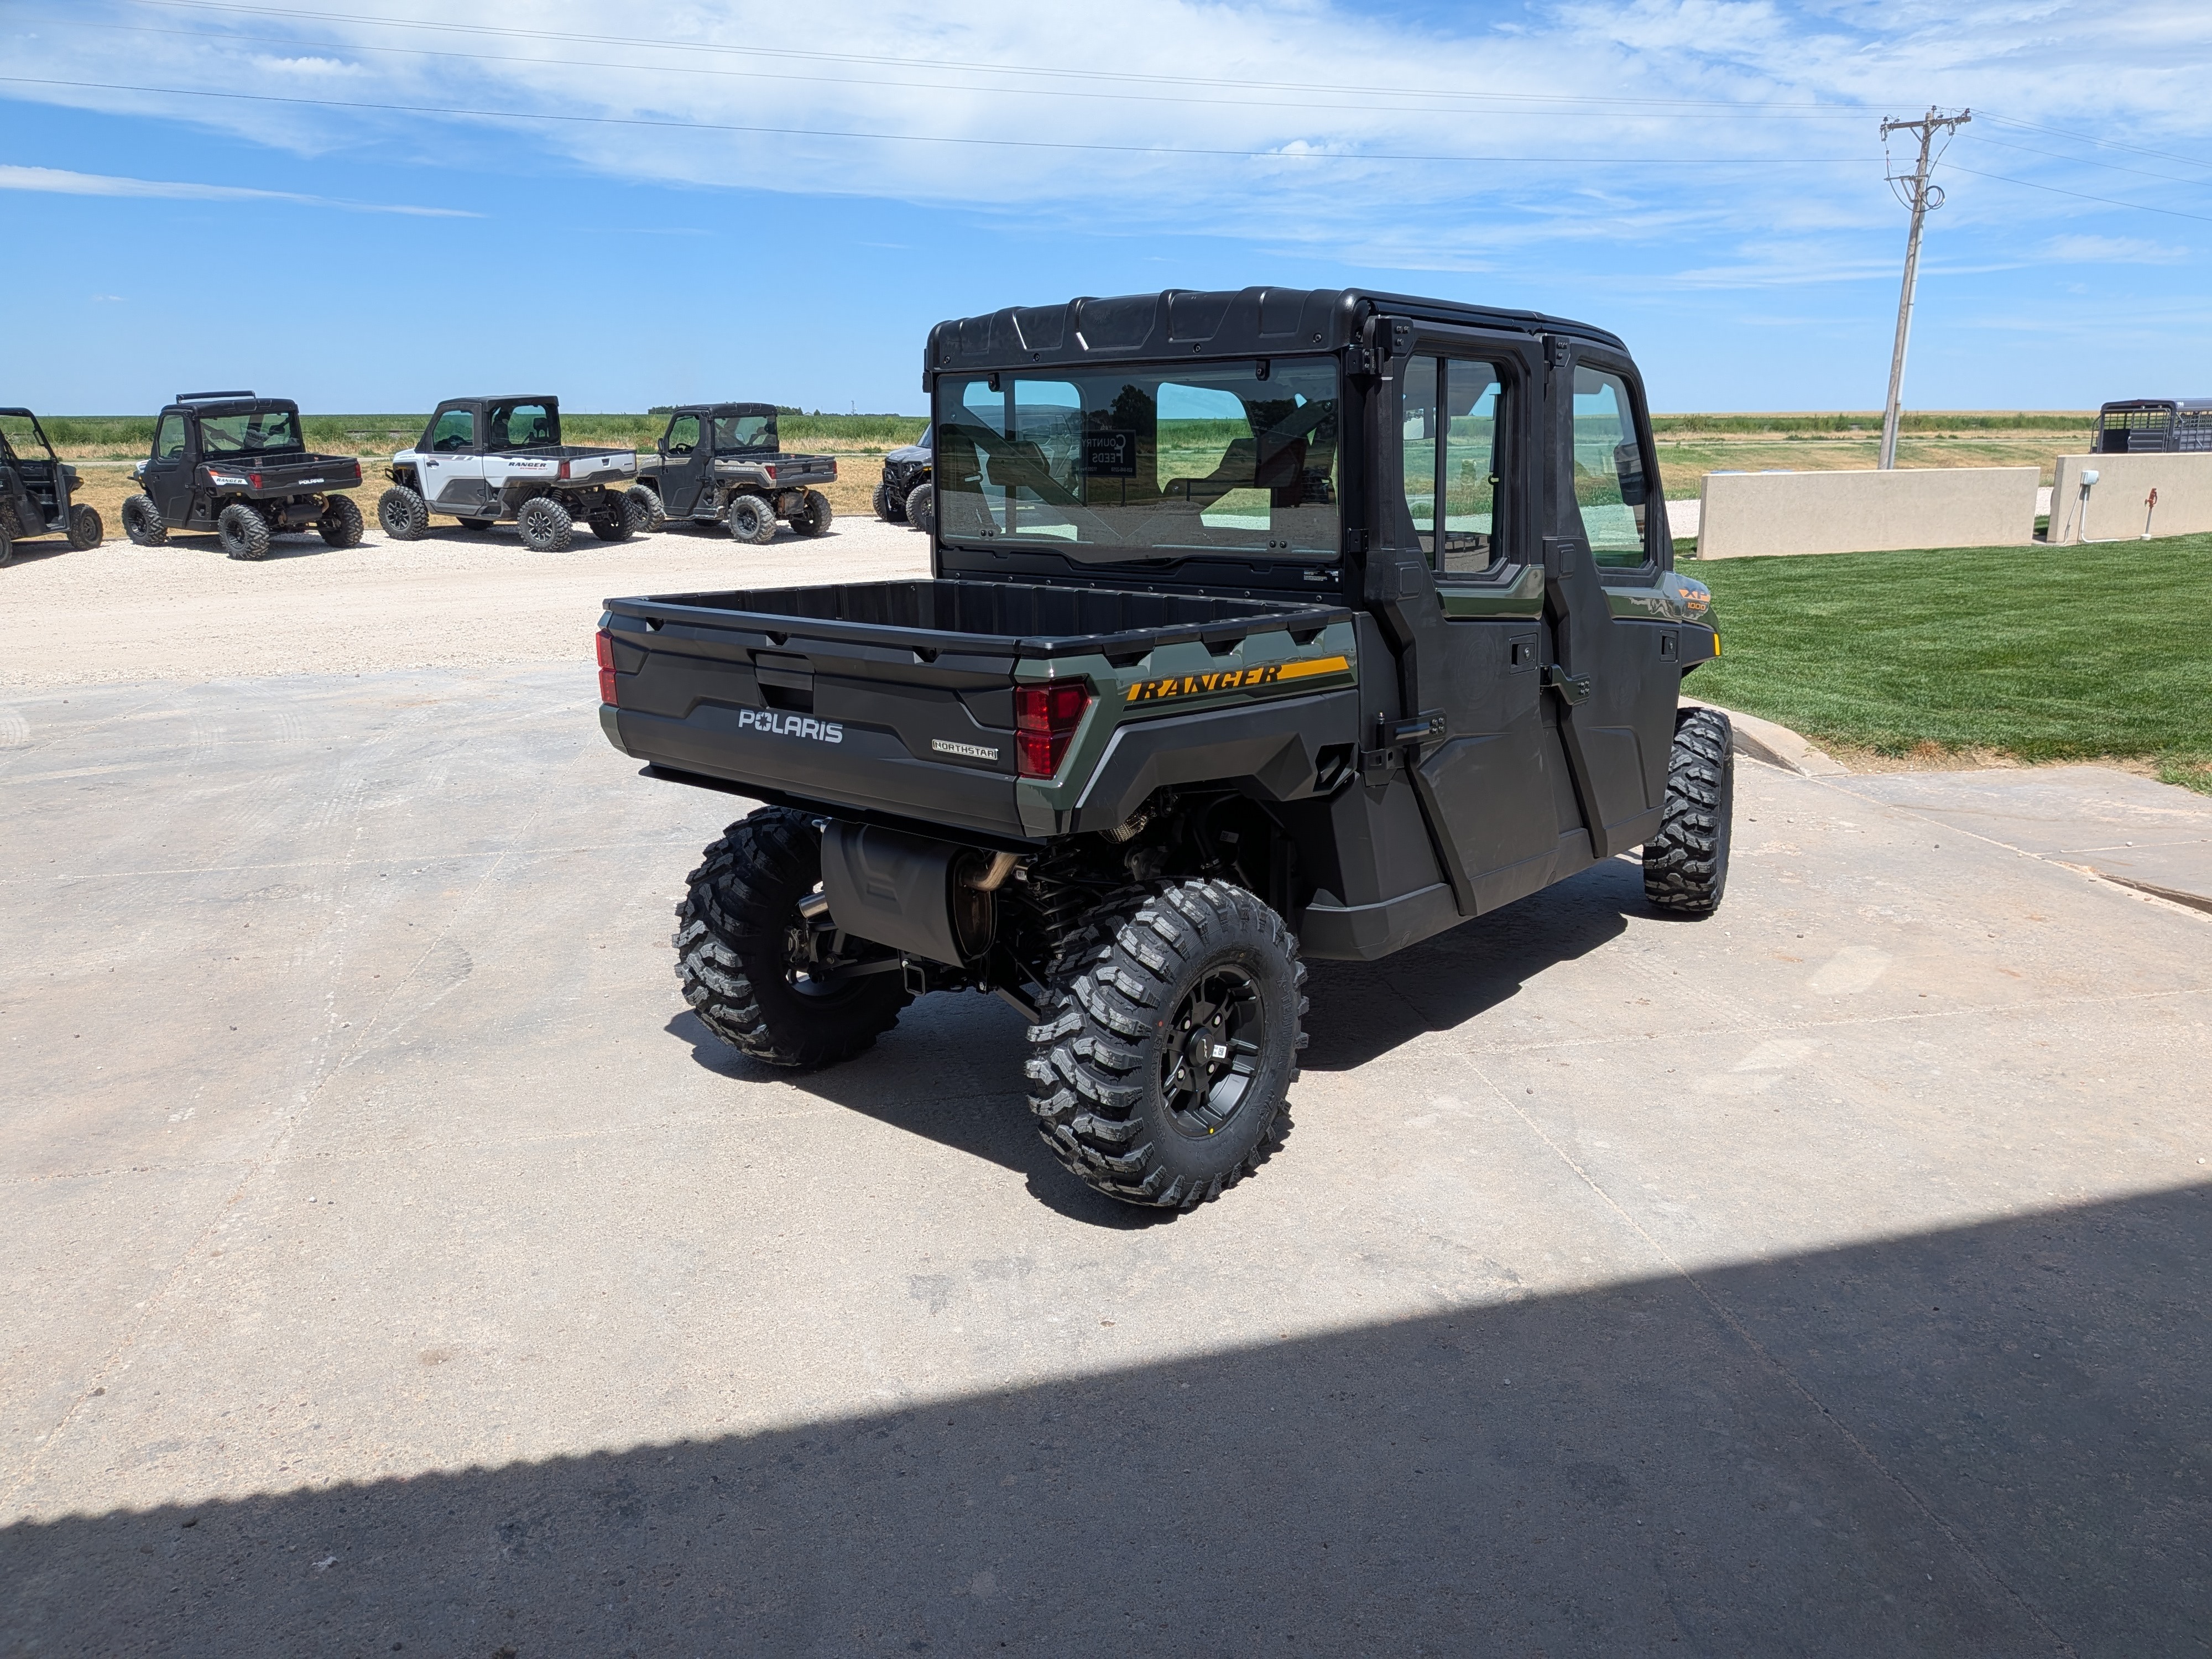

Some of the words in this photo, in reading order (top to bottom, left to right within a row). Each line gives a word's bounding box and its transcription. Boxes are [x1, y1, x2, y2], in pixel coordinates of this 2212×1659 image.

[1683, 586, 1708, 600] XP
[1687, 602, 1706, 611] 1000
[1134, 664, 1282, 701] RANGER
[738, 709, 843, 743] POLARIS
[935, 742, 994, 758] NORTHSTAR
[1275, 971, 1293, 1071] X-TERRAIN
